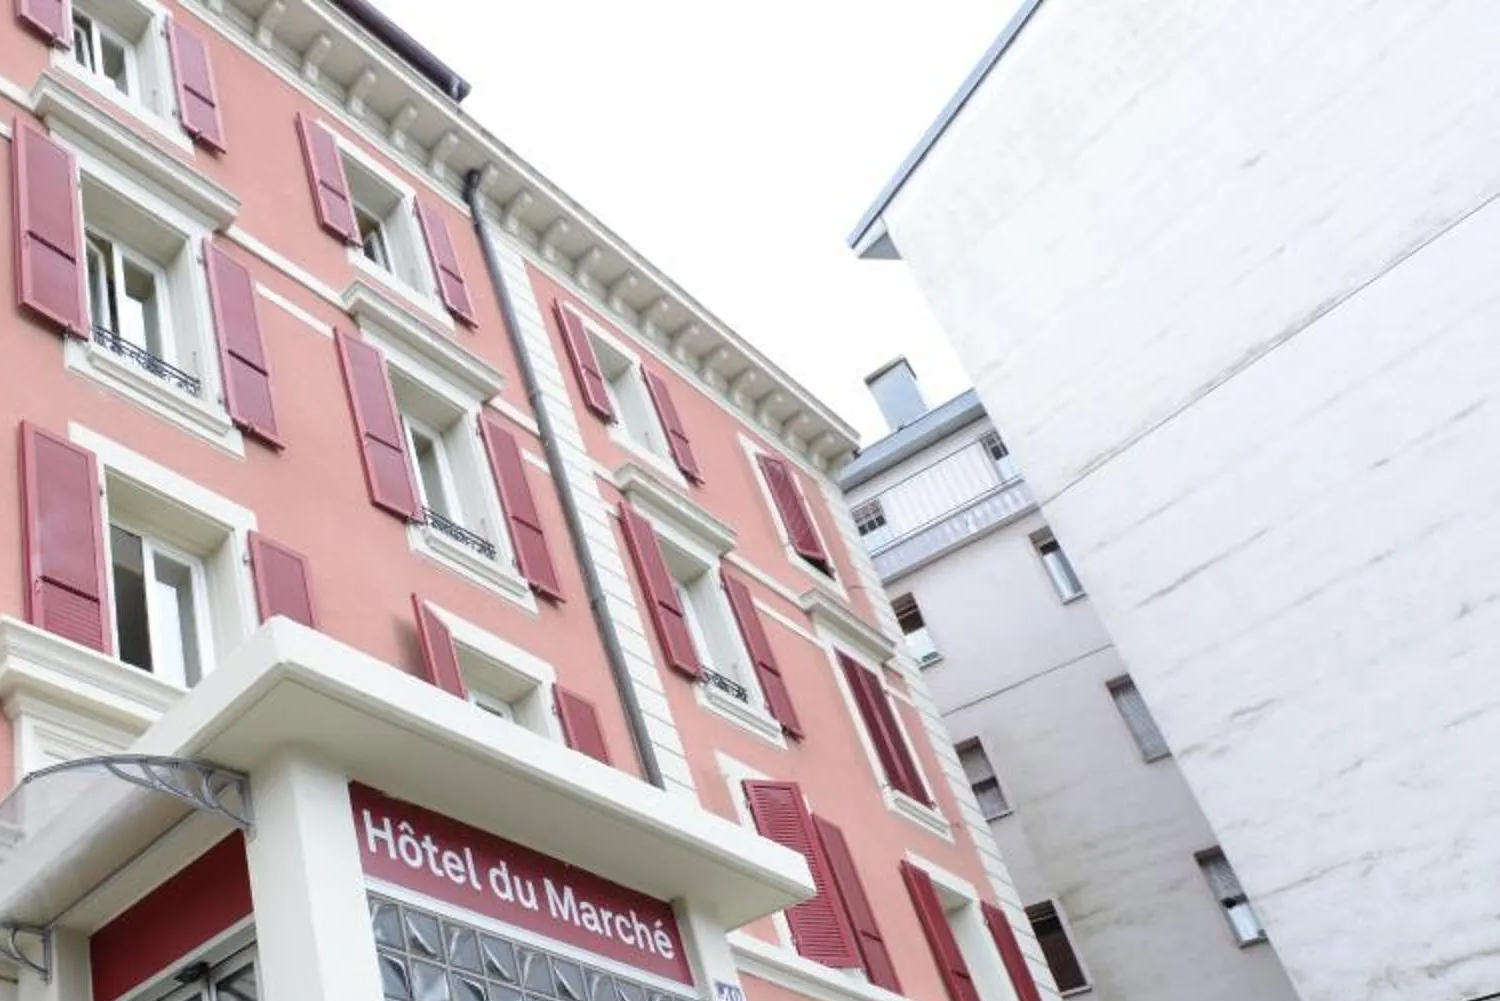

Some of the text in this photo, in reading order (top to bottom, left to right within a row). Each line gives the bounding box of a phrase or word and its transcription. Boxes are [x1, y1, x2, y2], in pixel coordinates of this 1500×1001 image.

[362, 808, 675, 960] Hôtel du Marché
